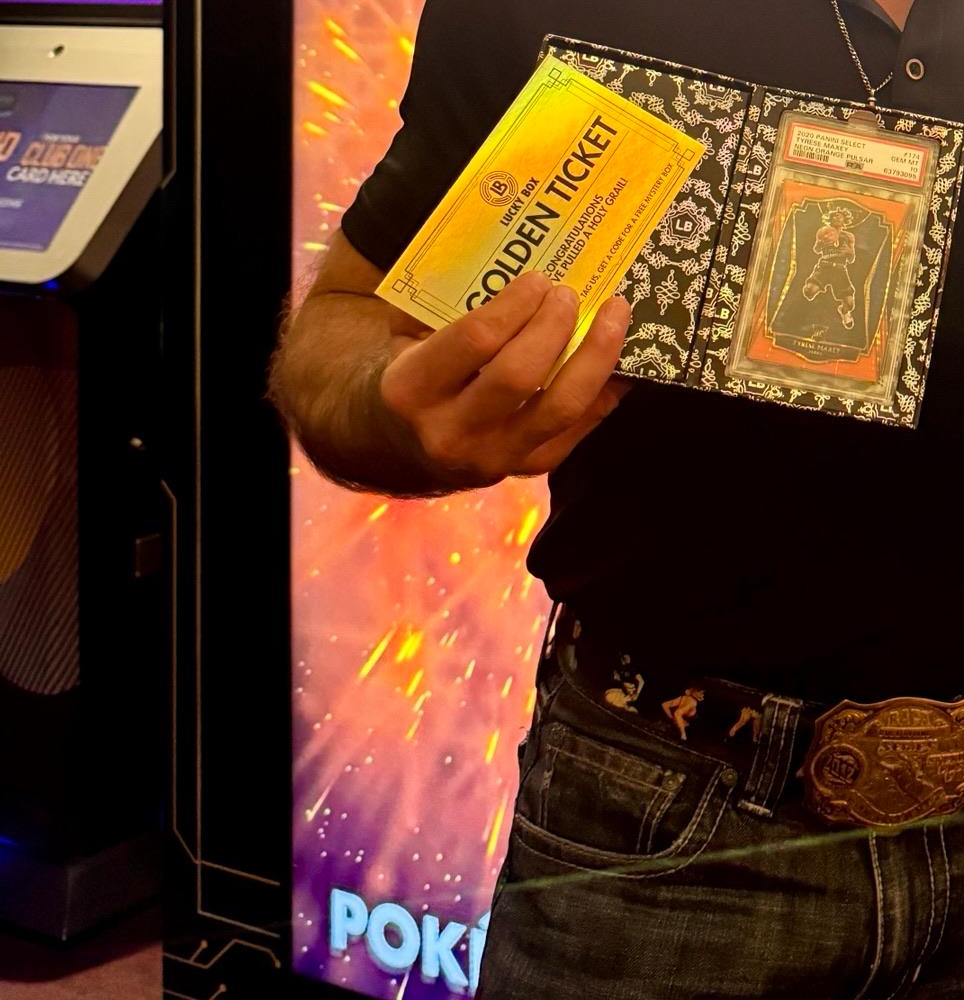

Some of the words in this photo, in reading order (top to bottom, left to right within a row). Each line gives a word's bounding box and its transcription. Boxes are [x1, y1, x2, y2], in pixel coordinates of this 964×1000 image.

[794, 144, 814, 153] NEON
[815, 148, 845, 158] ORANGE
[846, 154, 874, 165] PULSAR
[796, 137, 821, 147] TYRESE
[823, 142, 849, 152] MAXEY
[797, 130, 814, 139] 2020
[815, 133, 839, 143] PANINI
[841, 139, 866, 149] SELECT
[6, 166, 49, 183] CARD
[465, 201, 561, 312] GOLDEN
[544, 115, 618, 203] TICKET
[500, 197, 526, 227] LUCKY
[522, 176, 541, 198] BOX
[563, 238, 586, 271] PULLED
[589, 206, 609, 231] HOLY
[580, 283, 594, 299] TAG
[597, 258, 610, 273] GET
[610, 236, 624, 254] CODE
[621, 223, 633, 239] FOR
[635, 201, 648, 218] FREE
[644, 174, 664, 204] MYSTERY
[661, 163, 673, 178] BOX
